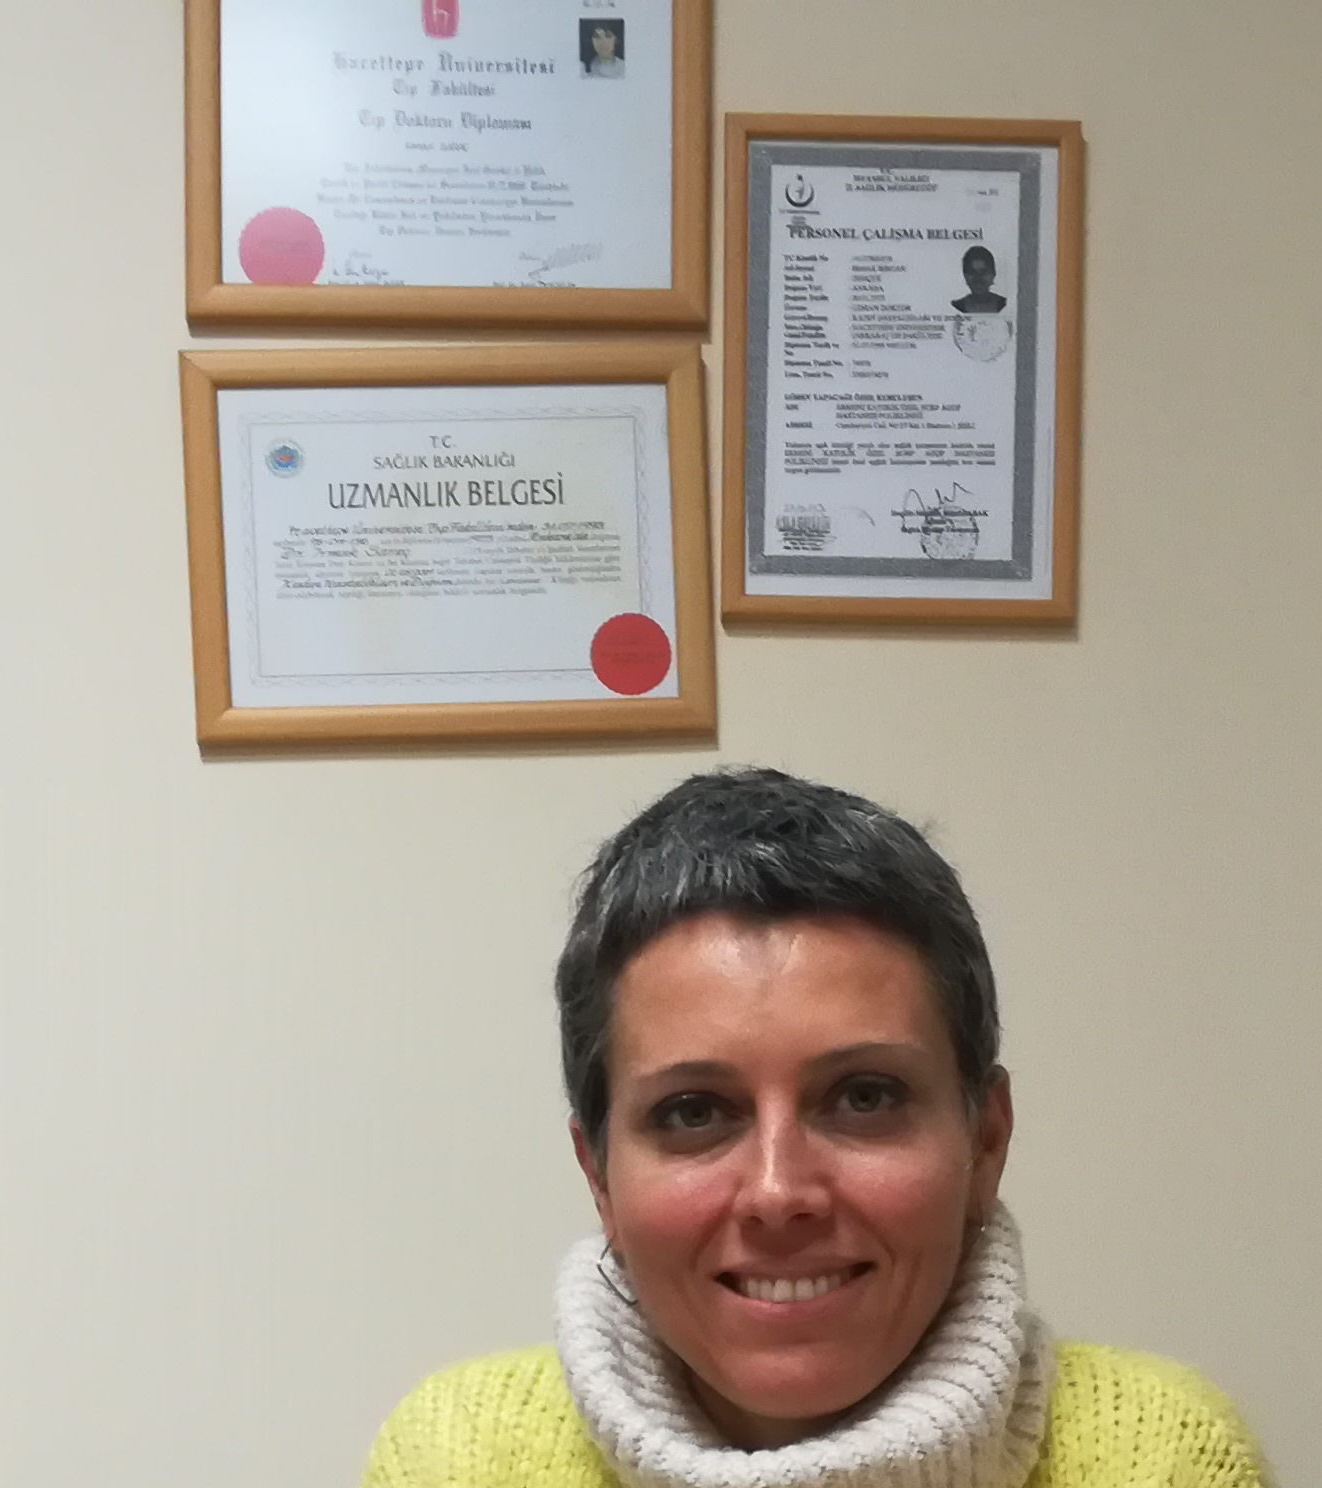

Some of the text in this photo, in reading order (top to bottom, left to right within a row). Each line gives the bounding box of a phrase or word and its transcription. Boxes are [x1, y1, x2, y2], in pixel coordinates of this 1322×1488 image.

[790, 227, 857, 239] PERSONEL
[373, 452, 516, 470] SAĞLIK BAKANLIĞI
[328, 472, 565, 509] UZMANLIK BELGESİ
